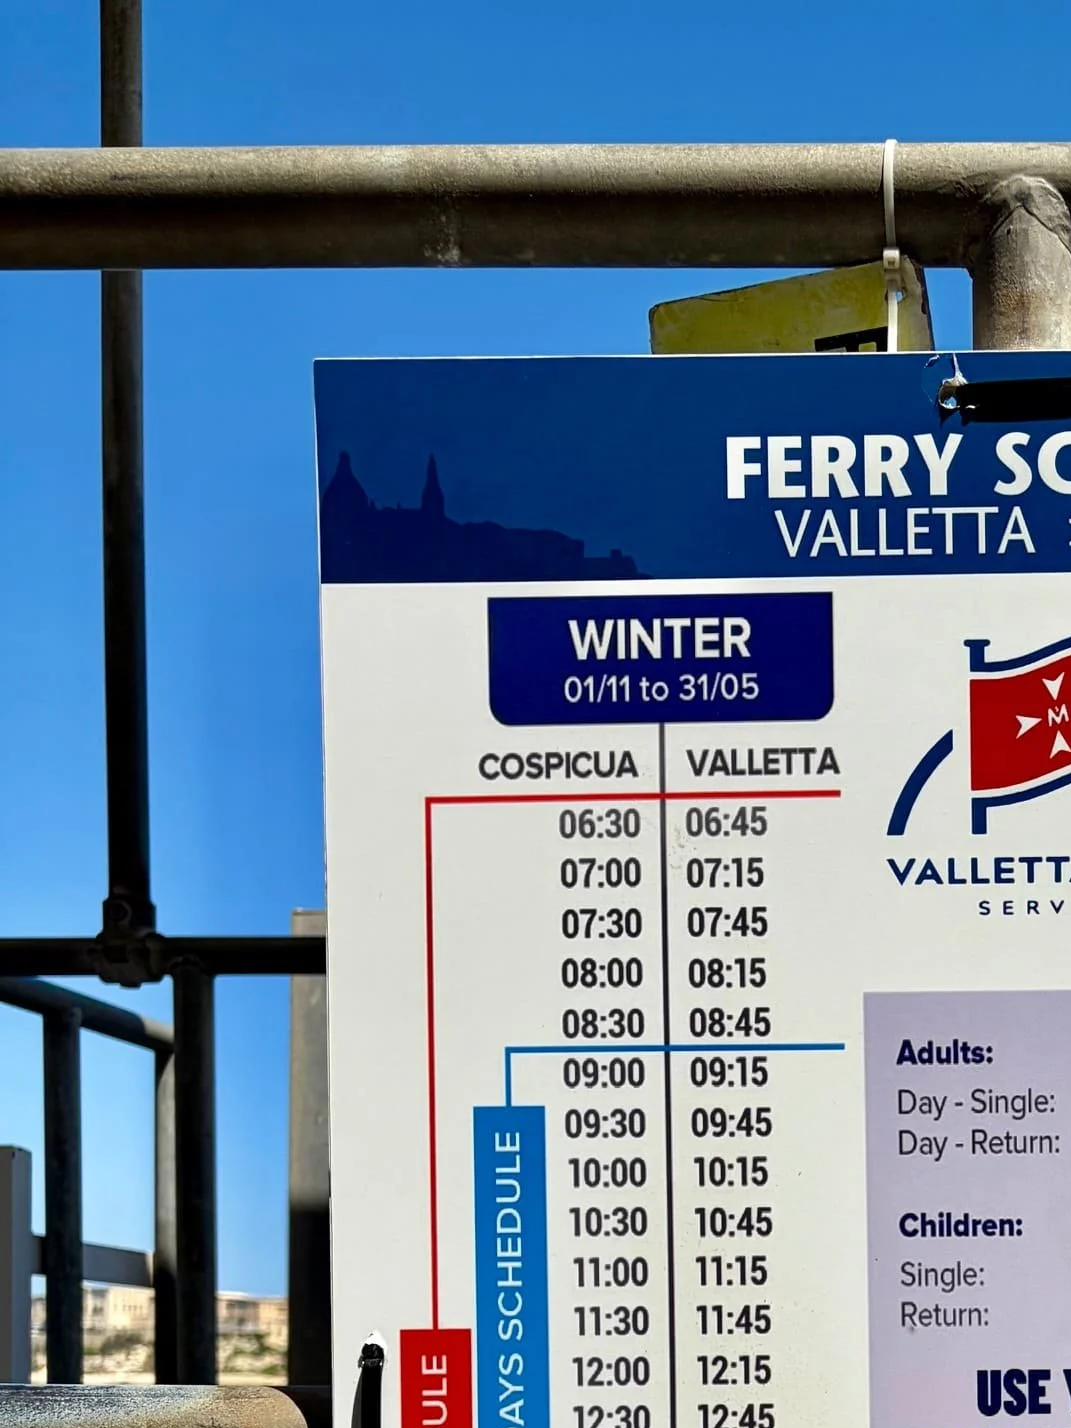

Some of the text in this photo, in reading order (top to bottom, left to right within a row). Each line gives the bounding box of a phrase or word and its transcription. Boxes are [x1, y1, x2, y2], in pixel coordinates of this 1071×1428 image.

[726, 432, 964, 499] FERRY
[774, 505, 1036, 558] VALLETTA
[567, 616, 751, 660] WINTER
[564, 671, 759, 703] 01/11 to 31/05
[478, 746, 841, 781] COSPICUA VALLETTA
[559, 806, 768, 839] 06:30 06:45
[562, 1006, 771, 1039] 08:30 08:45
[896, 1038, 994, 1066] Adults:
[897, 1088, 948, 1122] Day
[971, 1087, 1055, 1121] Single:
[898, 1129, 948, 1162] Day
[971, 1128, 1060, 1155] Return:
[494, 1132, 523, 1341] SCHEDULE
[569, 1206, 773, 1238] 10:30 10:45
[898, 1211, 1023, 1238] Children:
[900, 1260, 985, 1294] Single:
[901, 1301, 989, 1327] Return:
[976, 1368, 1052, 1417] USE
